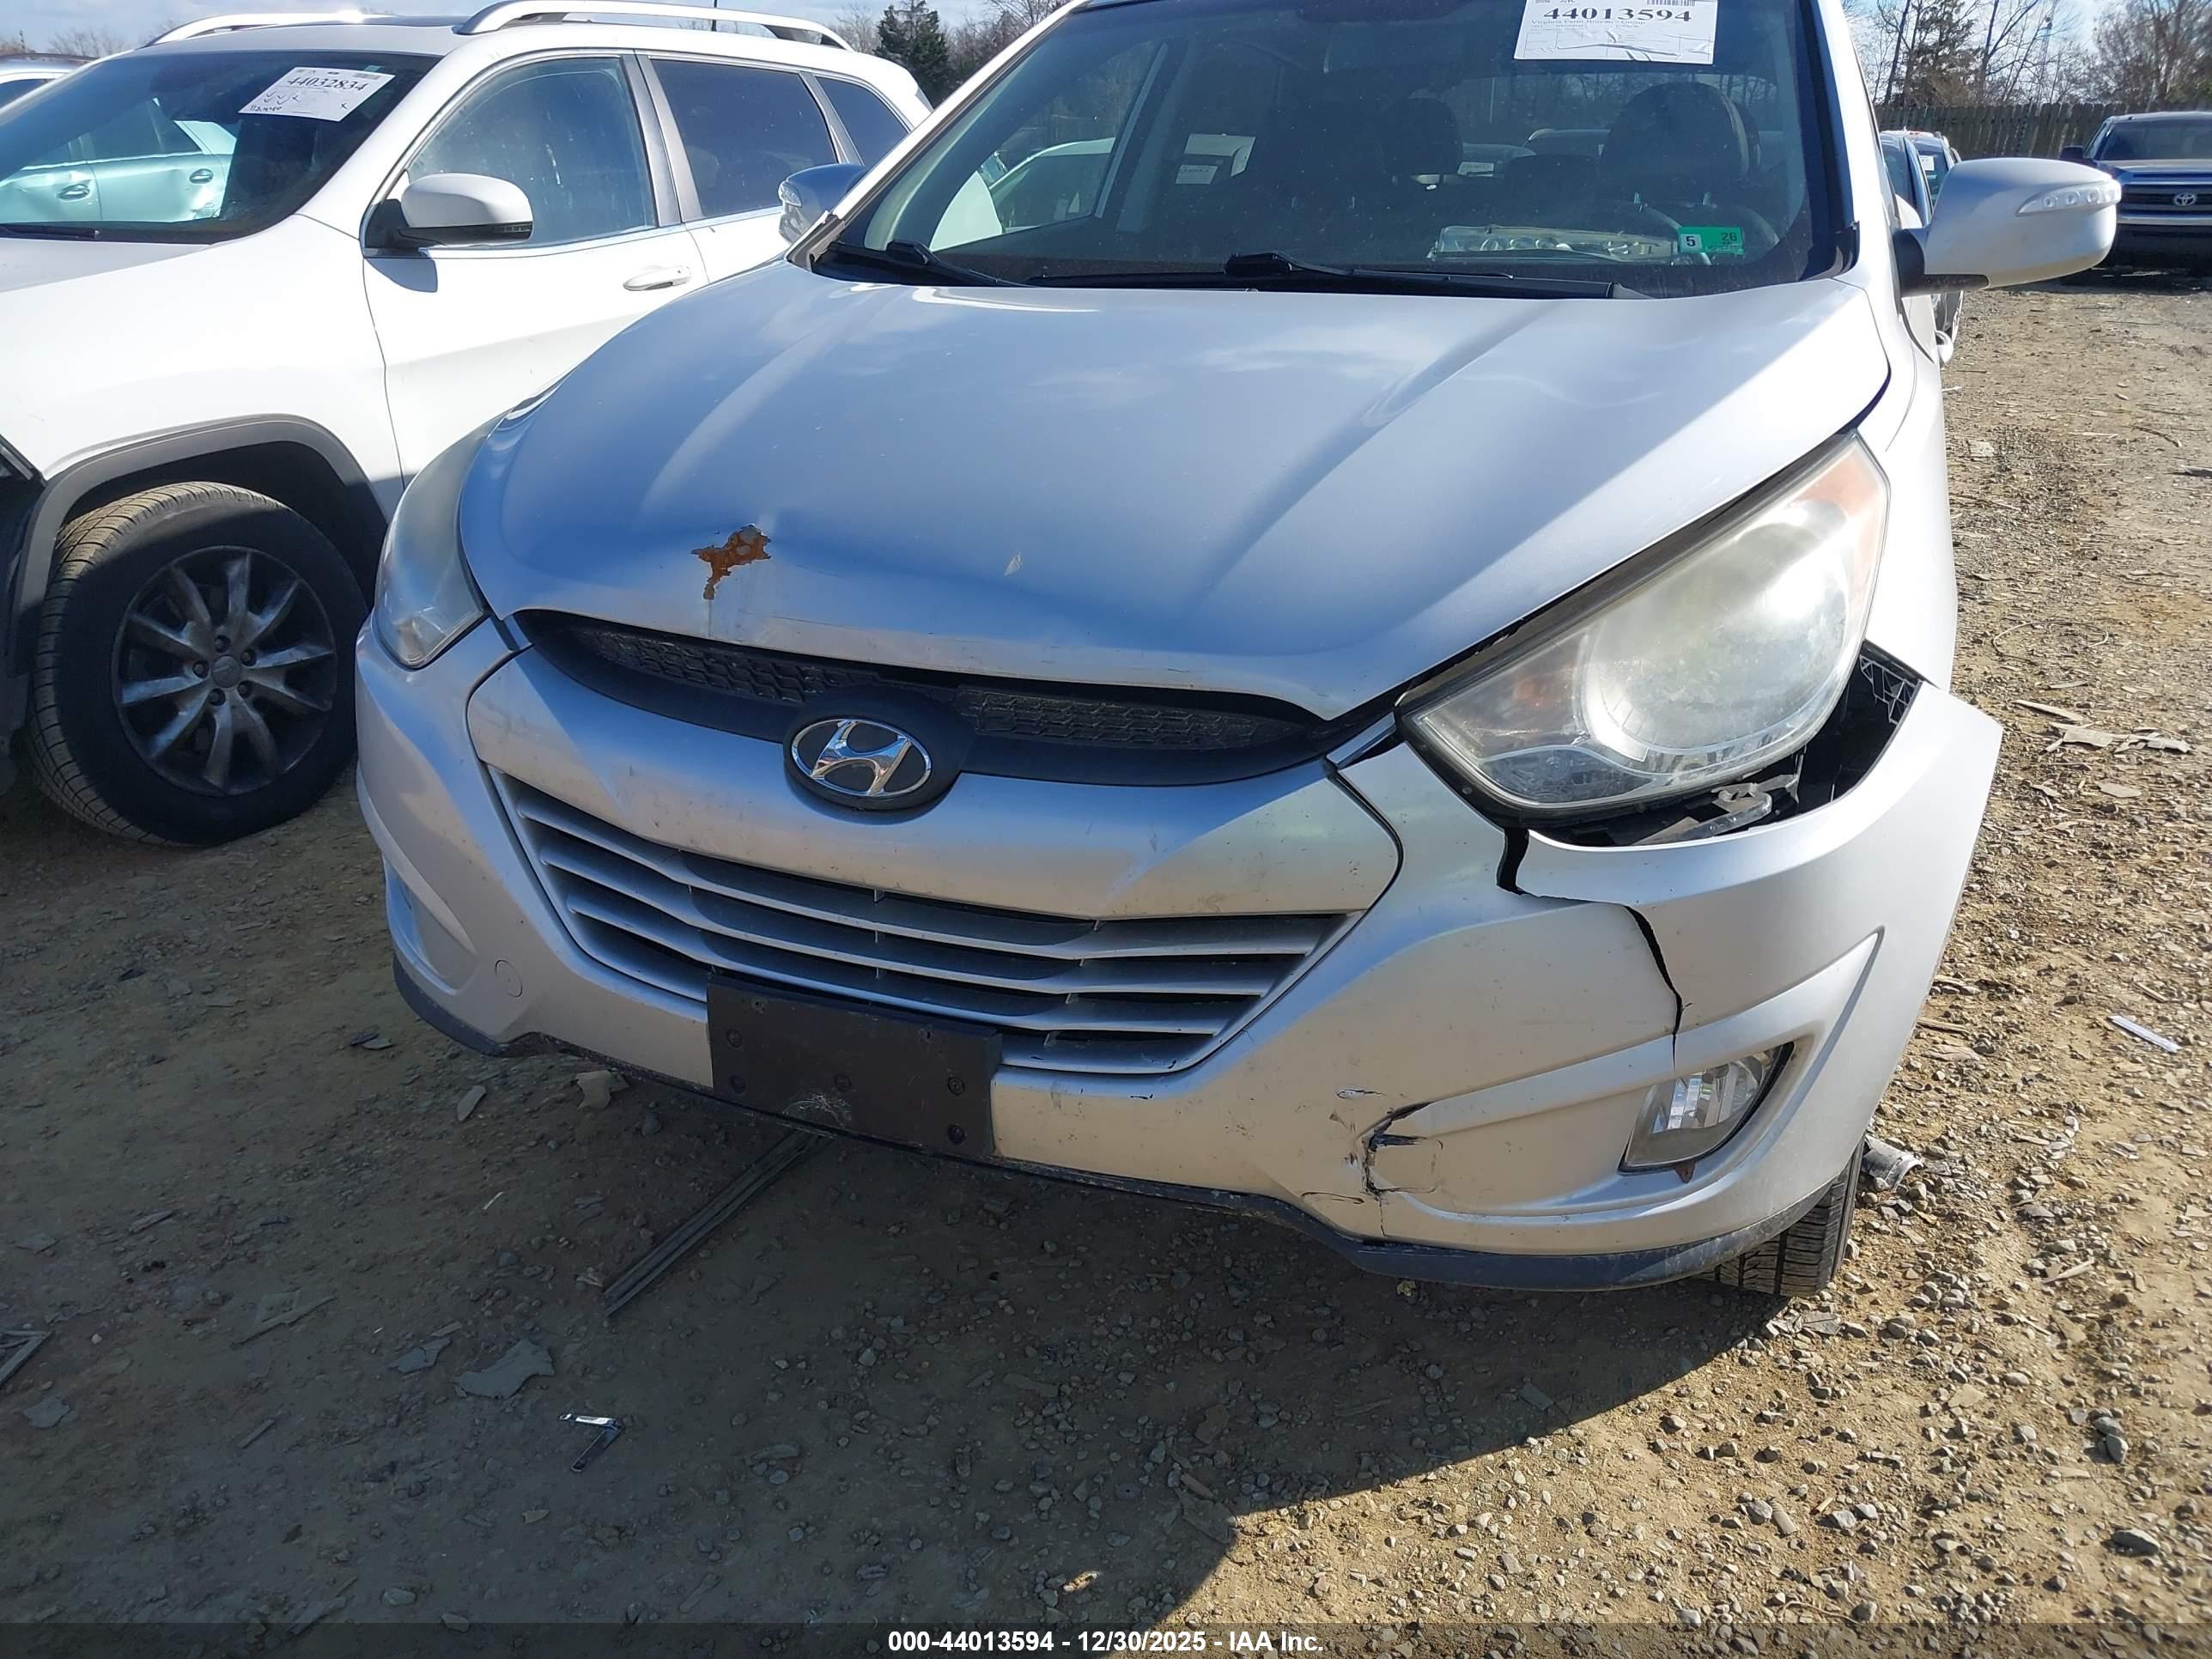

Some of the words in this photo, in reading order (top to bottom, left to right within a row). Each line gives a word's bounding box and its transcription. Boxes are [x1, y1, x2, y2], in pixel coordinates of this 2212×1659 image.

[1543, 7, 1692, 21] 44013594
[287, 76, 369, 91] 44032834
[1686, 235, 1697, 247] 5
[1721, 232, 1738, 242] 26
